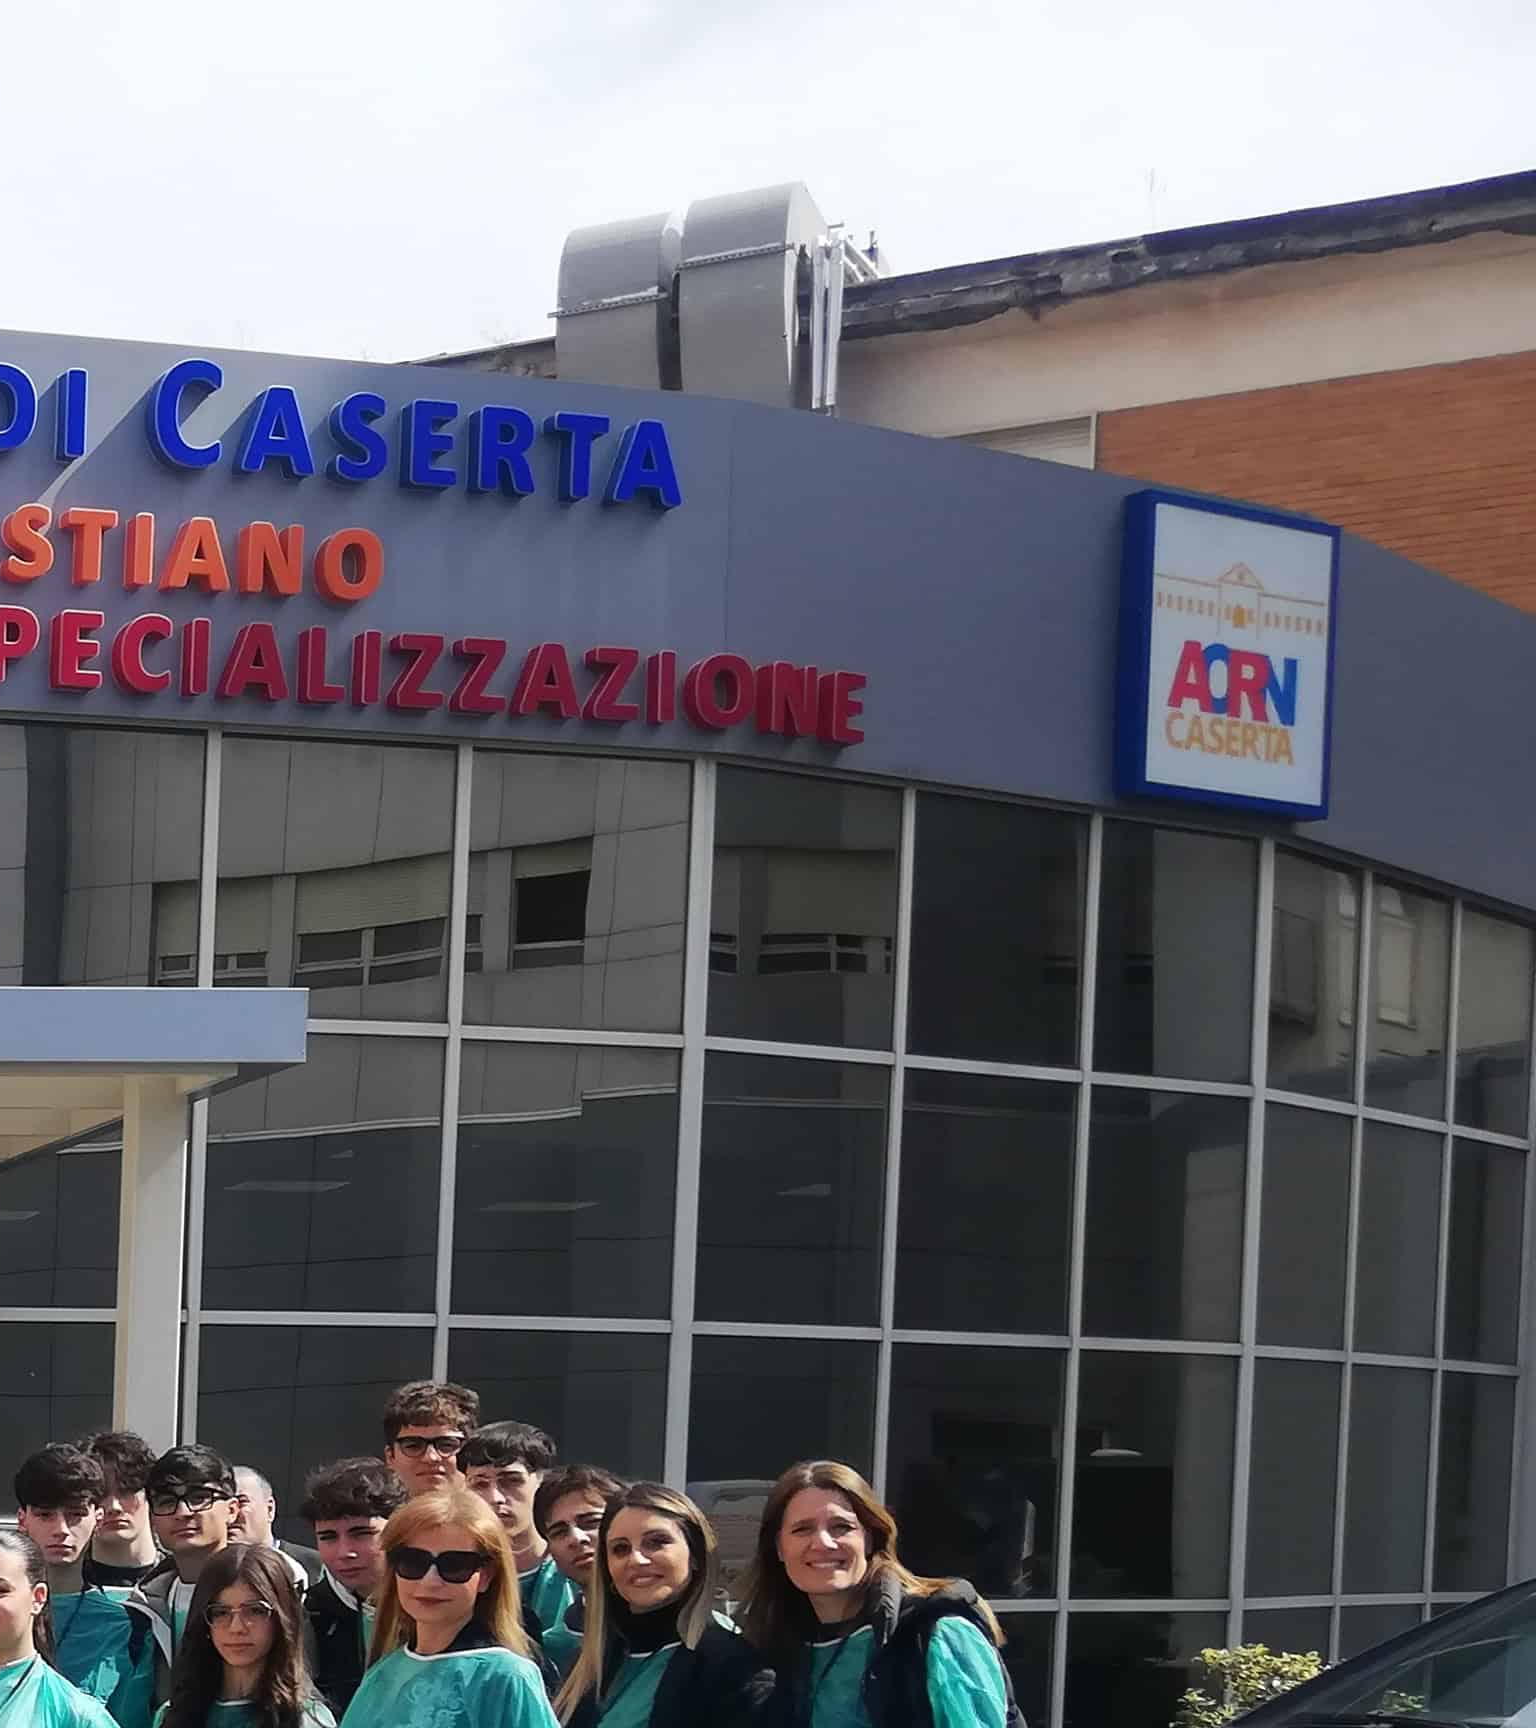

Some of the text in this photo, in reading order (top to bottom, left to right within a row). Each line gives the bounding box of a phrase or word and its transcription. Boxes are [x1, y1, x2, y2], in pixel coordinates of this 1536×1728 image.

[158, 358, 682, 508] CASERTA
[1167, 639, 1299, 727] AORN
[1164, 710, 1295, 766] CASERTA
